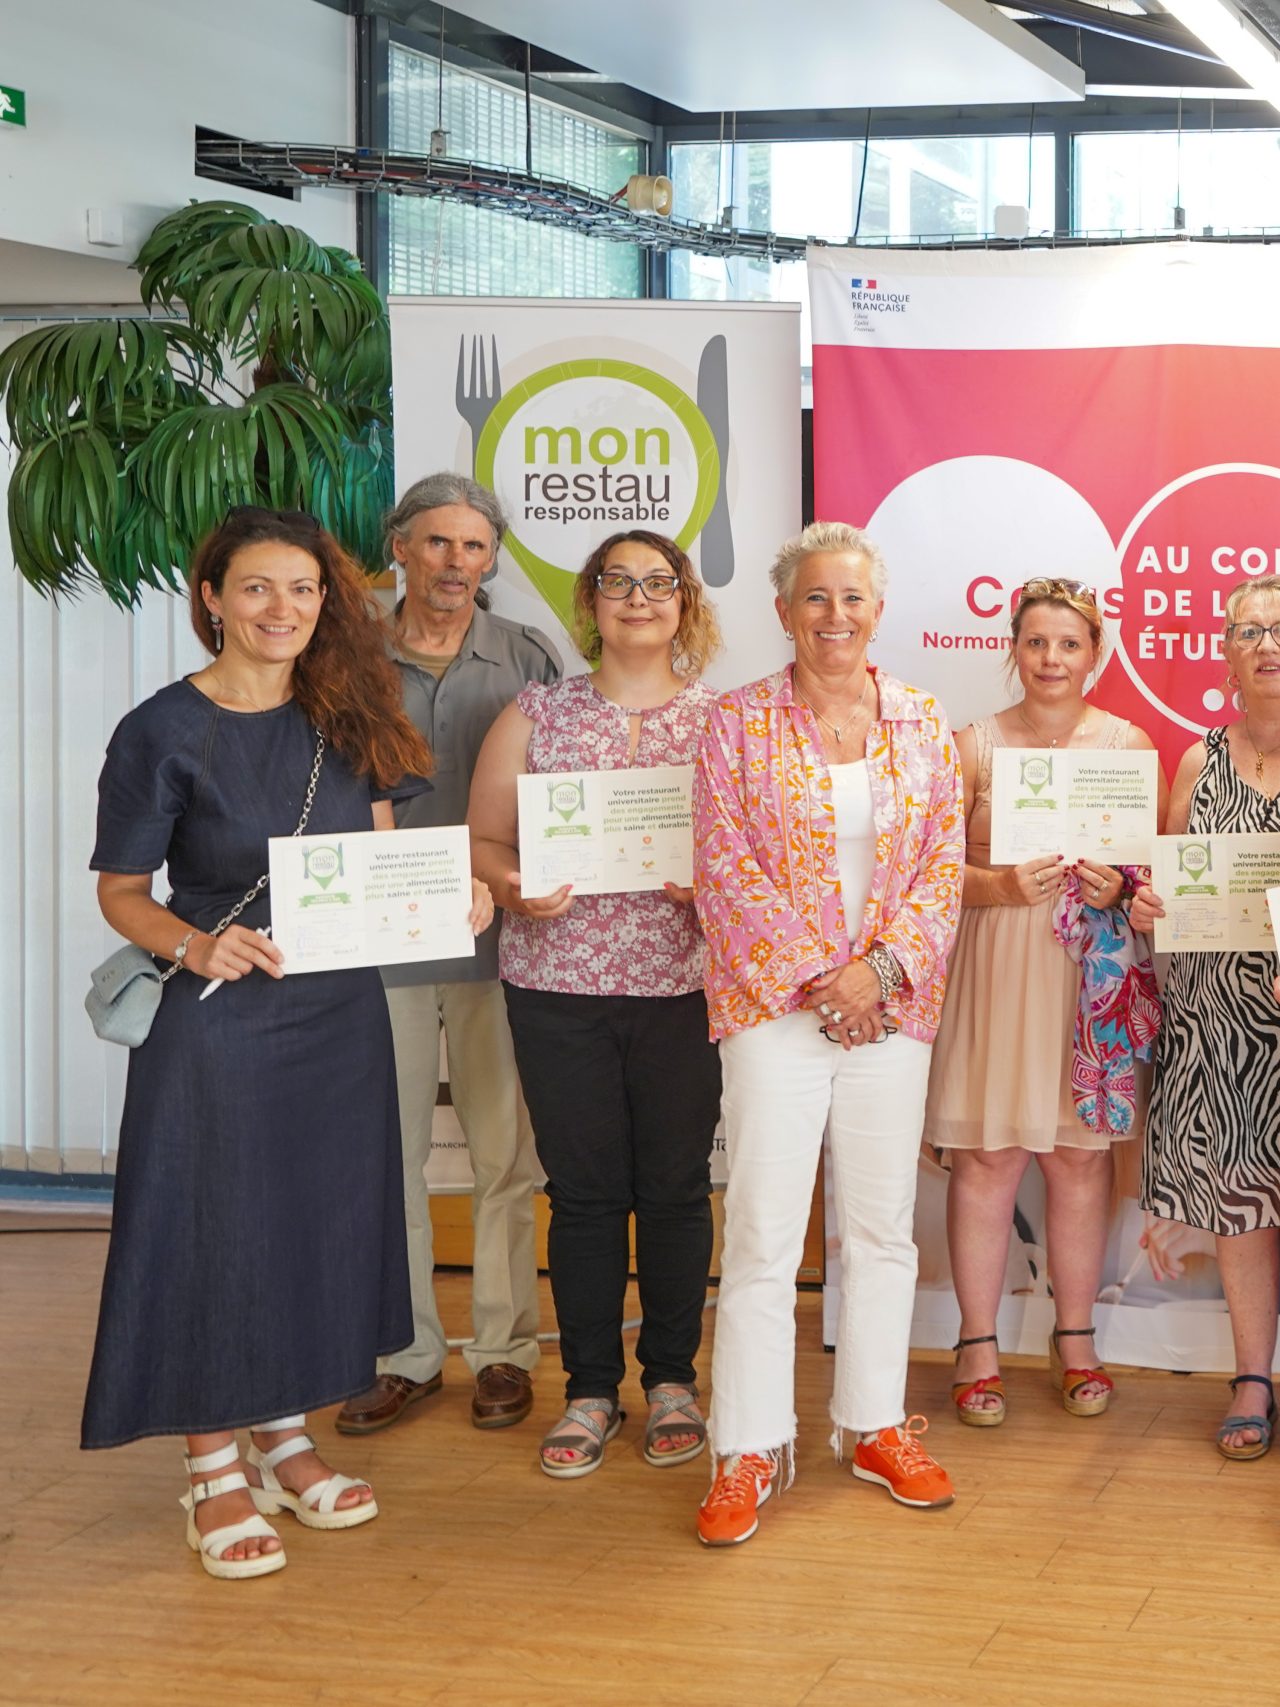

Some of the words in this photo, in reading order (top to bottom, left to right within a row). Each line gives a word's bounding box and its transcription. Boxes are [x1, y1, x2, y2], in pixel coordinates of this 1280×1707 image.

[851, 290, 910, 304] RÉPUBLIQUE
[852, 302, 906, 312] FRANÇAISE
[525, 426, 670, 465] mon
[525, 466, 670, 502] restau
[524, 502, 670, 525] responsable
[1136, 546, 1190, 574] AU
[1144, 590, 1192, 617] DE
[923, 632, 1012, 650] Norman
[638, 786, 680, 794] restaurant
[608, 796, 660, 806] universitaire
[641, 812, 691, 822] alimentation
[624, 823, 645, 831] saine
[375, 852, 400, 861] Votre
[402, 849, 449, 859] restaurant
[369, 860, 426, 871] universitaire
[406, 877, 461, 887] alimentation
[387, 889, 411, 897] saine
[430, 1141, 468, 1150] EMARCHE
